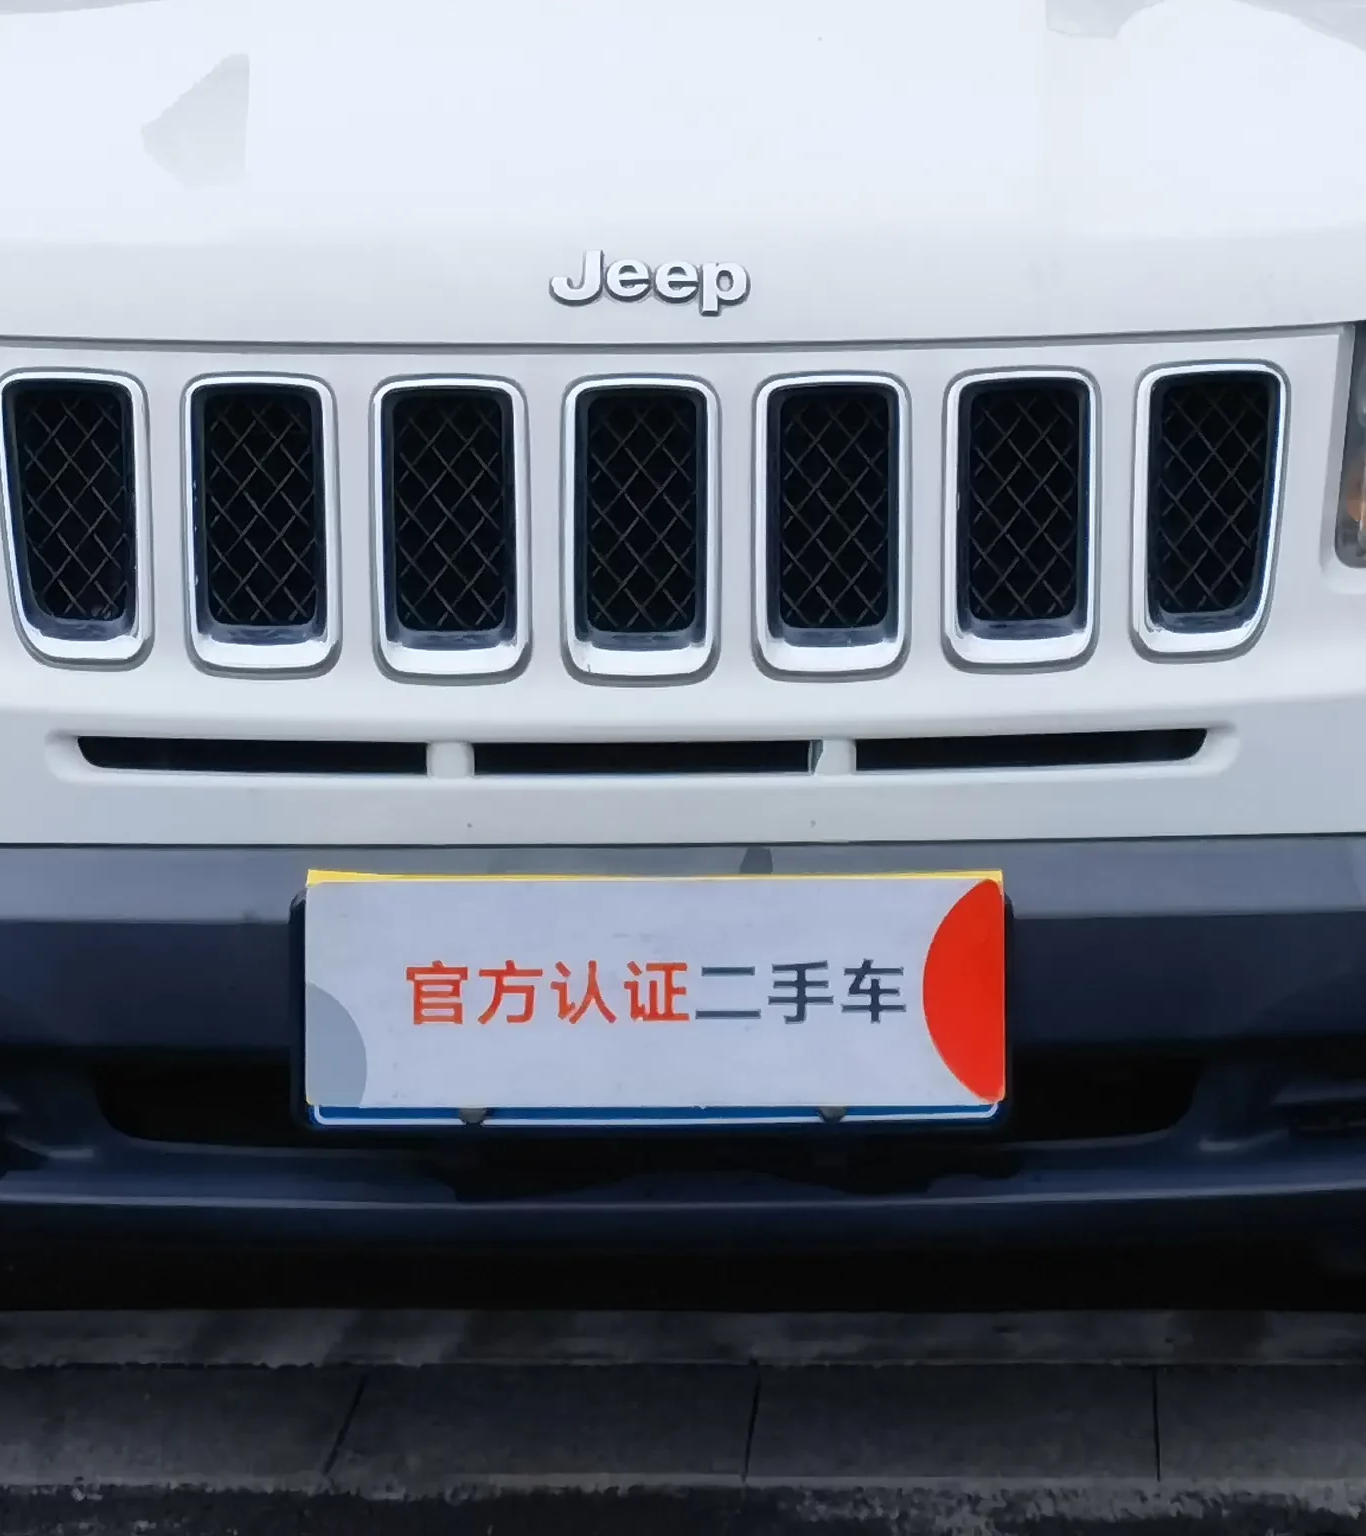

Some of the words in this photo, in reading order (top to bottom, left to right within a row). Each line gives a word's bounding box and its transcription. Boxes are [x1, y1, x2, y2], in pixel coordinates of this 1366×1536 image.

[549, 249, 751, 317] Jeep
[405, 959, 907, 1025] 官方认证二手车
